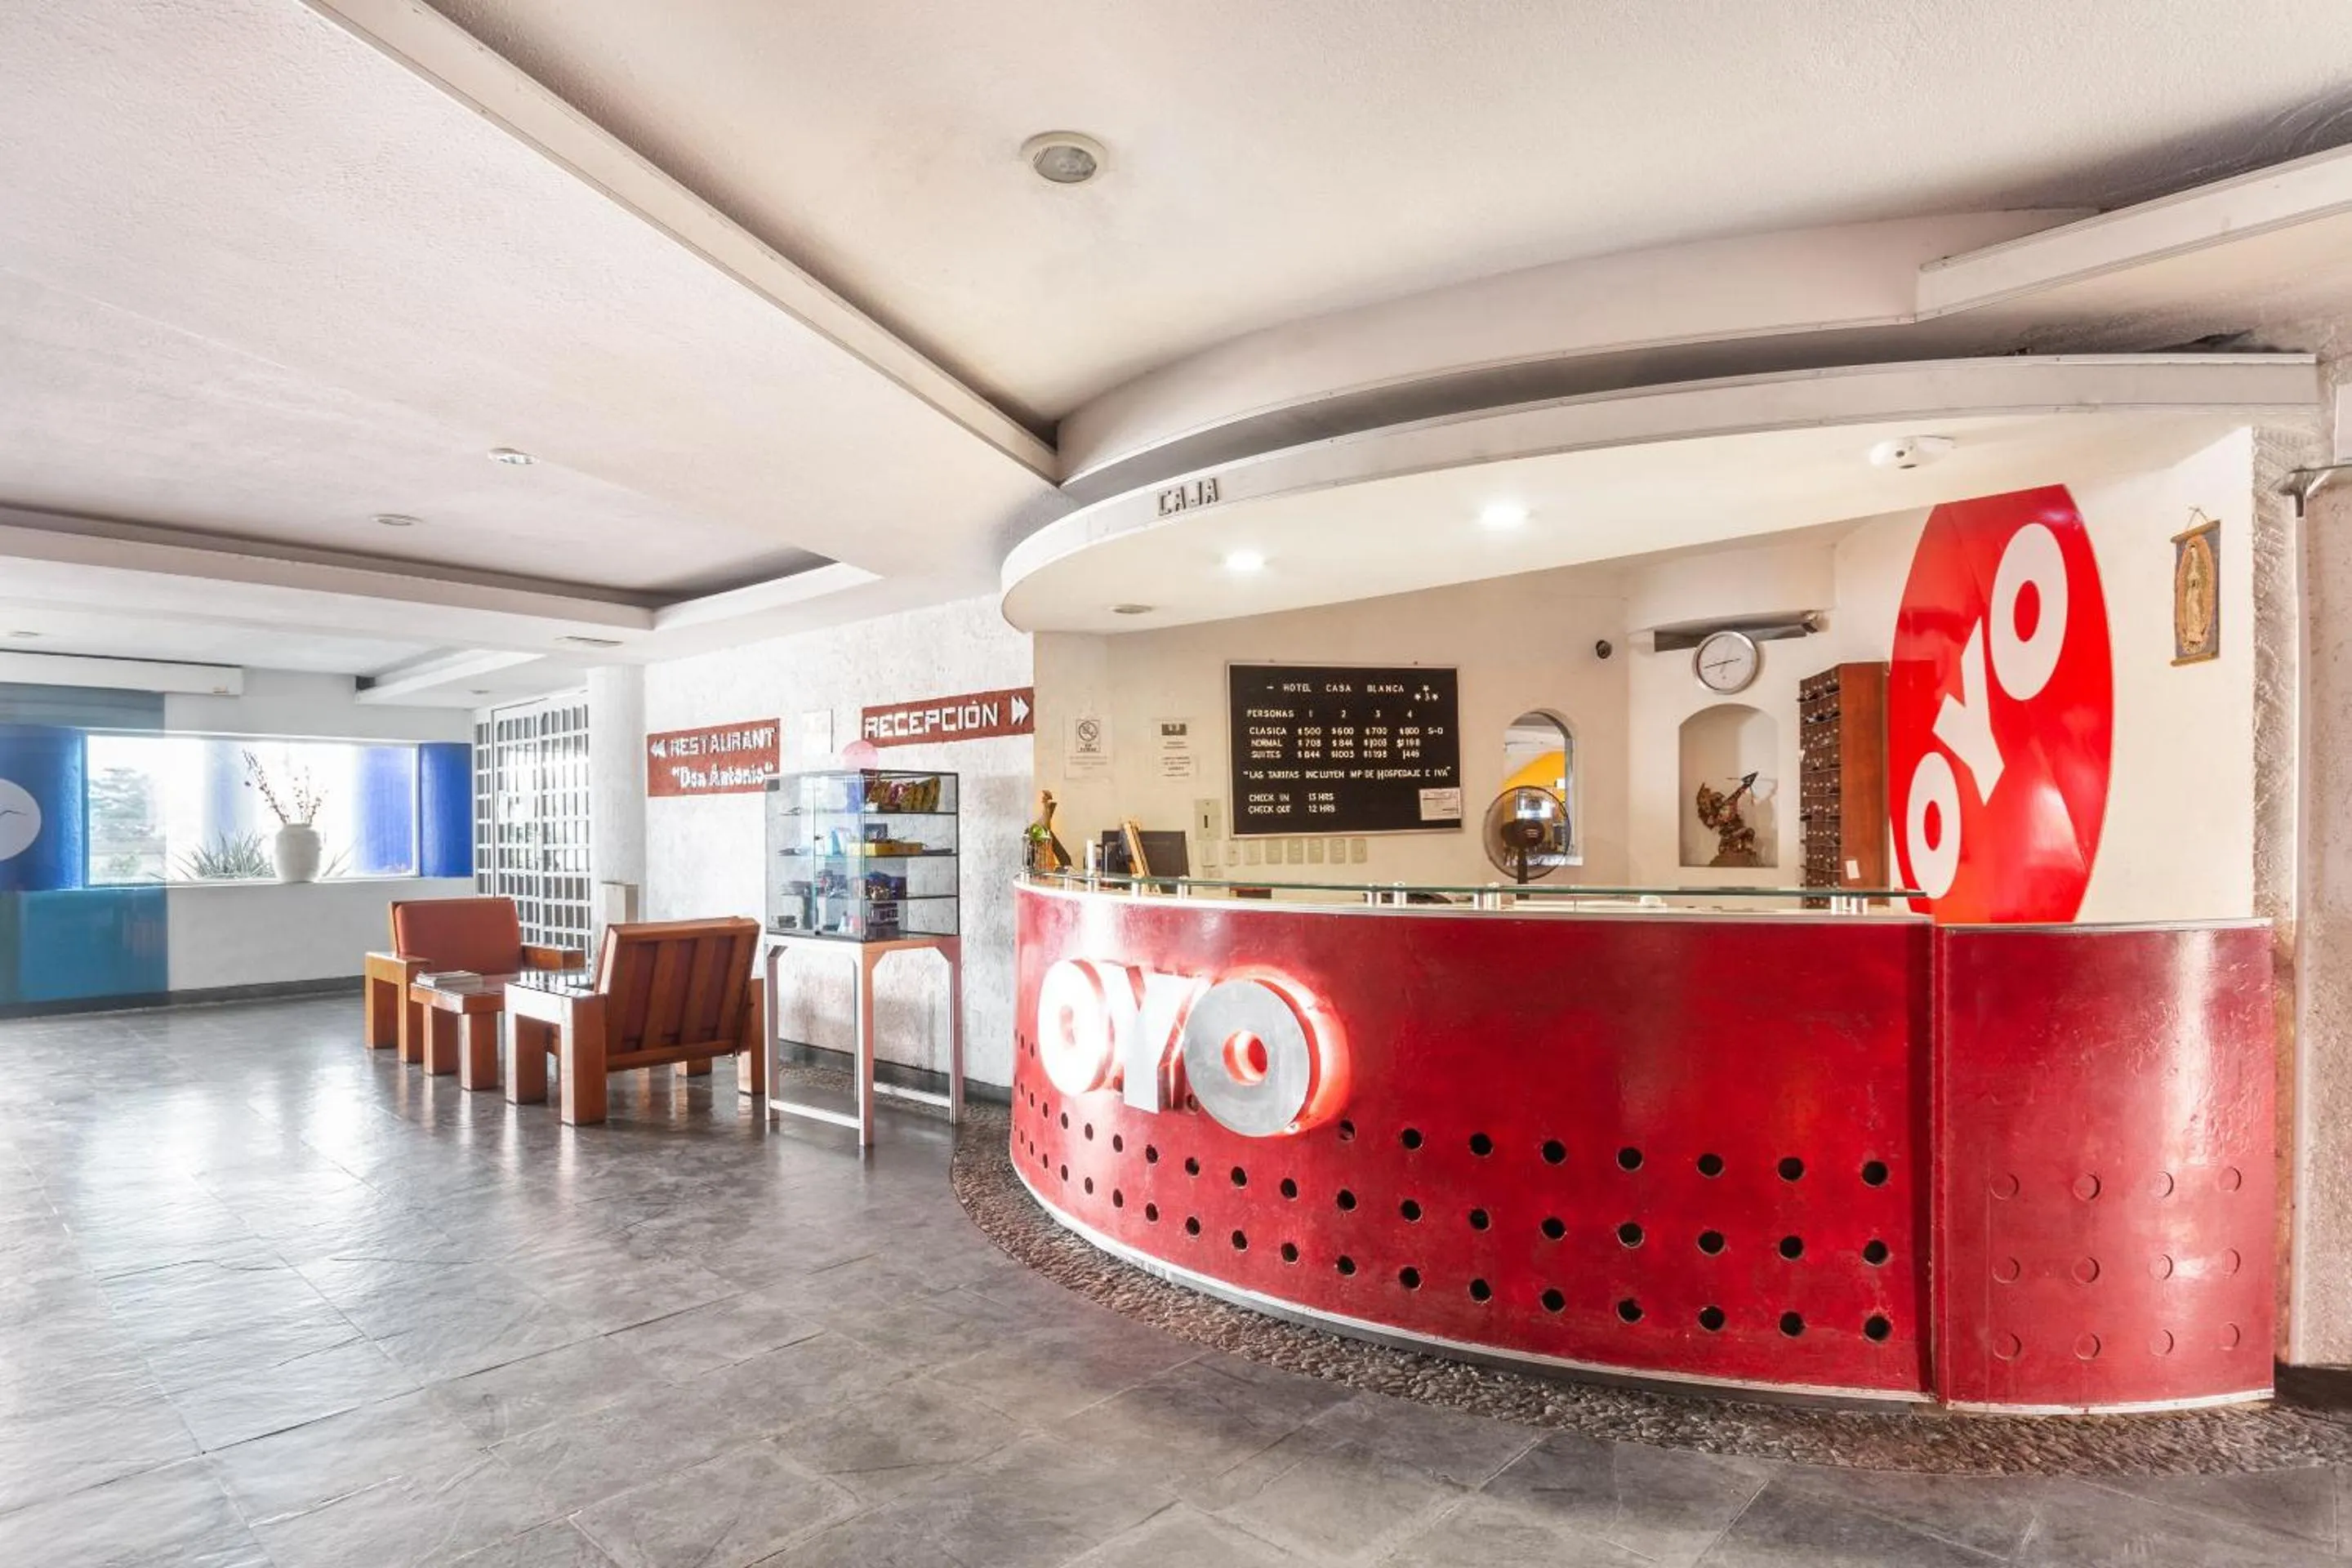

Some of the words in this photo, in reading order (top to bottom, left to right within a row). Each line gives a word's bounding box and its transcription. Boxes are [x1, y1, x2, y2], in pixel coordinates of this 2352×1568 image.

[1156, 476, 1219, 516] CAJA
[1282, 684, 1312, 693] HOTEL
[1325, 684, 1352, 693] CASA
[1366, 684, 1405, 693] BLANCA
[1246, 709, 1294, 718] PERSONAS
[1906, 523, 2069, 899] OYO
[864, 701, 998, 739] RECEPCIÓN
[1249, 727, 1287, 735] CLASICA
[670, 727, 775, 756] RESTAURANT
[1250, 738, 1283, 747] NORMAL
[1249, 793, 1274, 802] CHECK
[1248, 804, 1274, 814] CHECK
[1276, 804, 1291, 813] OUT
[1038, 959, 1343, 1138] OYO
